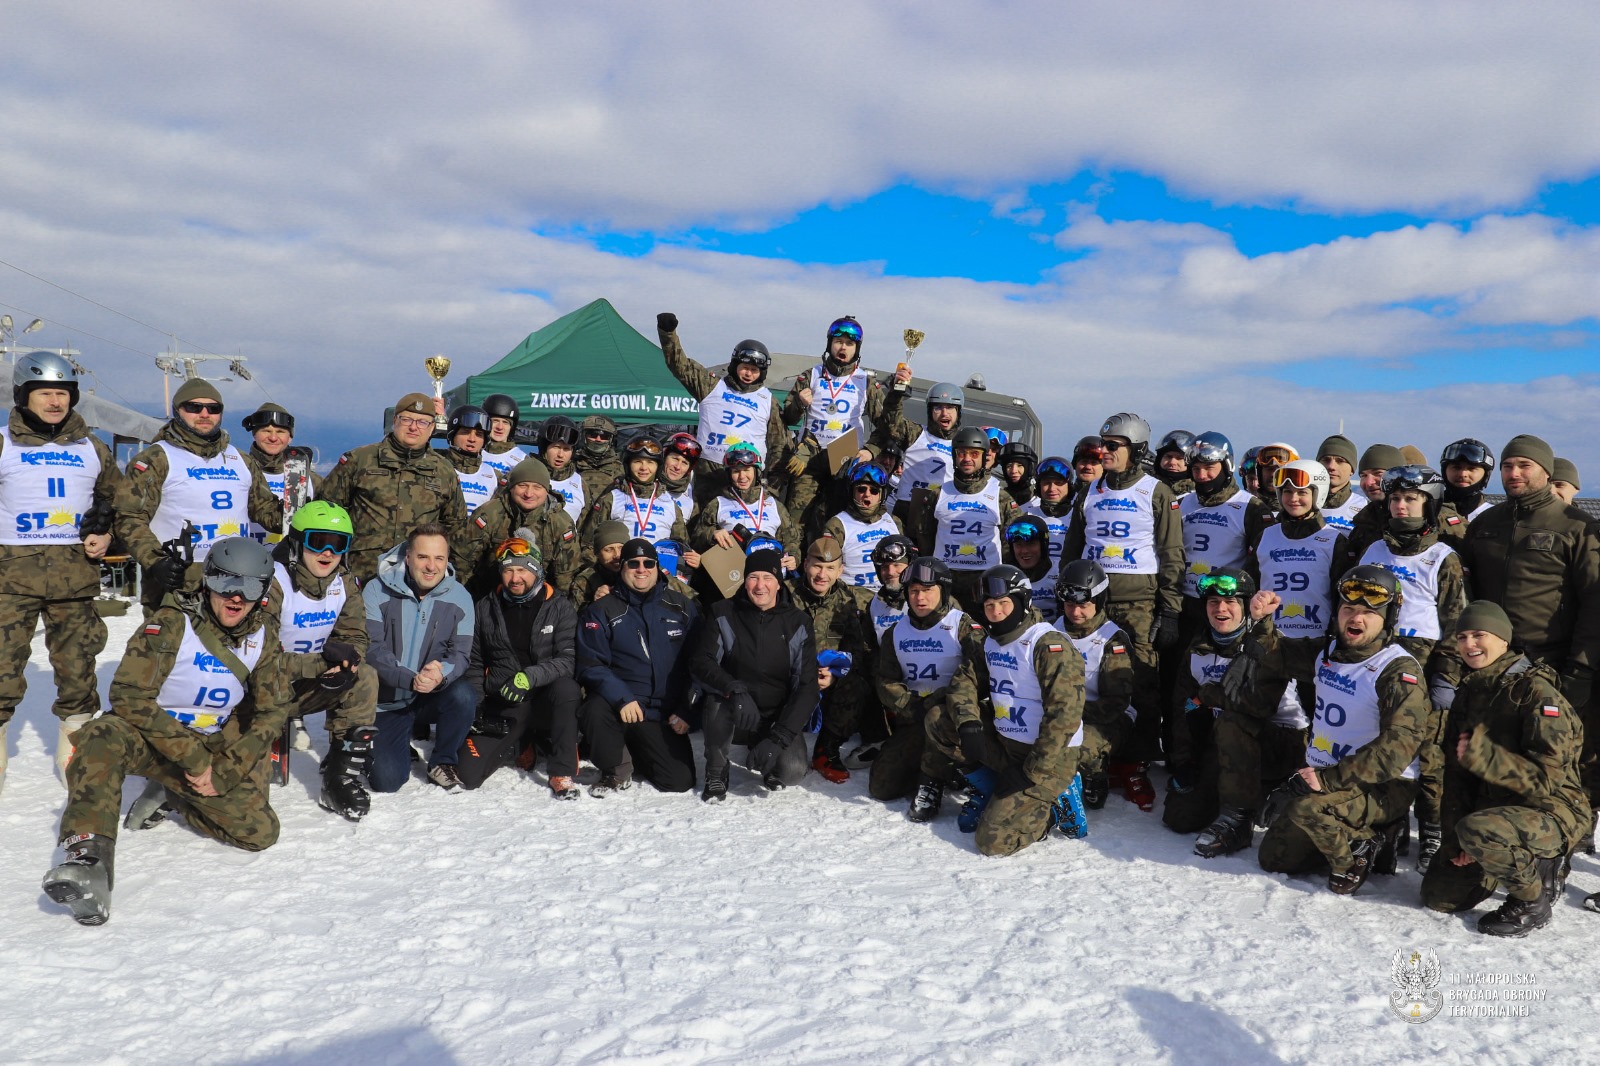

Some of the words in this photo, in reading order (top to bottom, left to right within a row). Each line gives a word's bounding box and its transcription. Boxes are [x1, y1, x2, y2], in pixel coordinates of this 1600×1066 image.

[531, 392, 587, 409] ZAWSZE
[590, 393, 650, 412] GOTOWI,
[654, 395, 700, 413] ZAWSZ
[821, 398, 850, 414] 30
[720, 410, 752, 428] 37
[48, 477, 65, 498] 11
[210, 490, 233, 510] 8
[634, 521, 657, 539] 12
[950, 520, 983, 536] 24
[1096, 520, 1131, 538] 38
[1193, 533, 1210, 552] 3
[1273, 572, 1310, 592] 39
[906, 663, 940, 681] 34
[193, 687, 231, 709] 19
